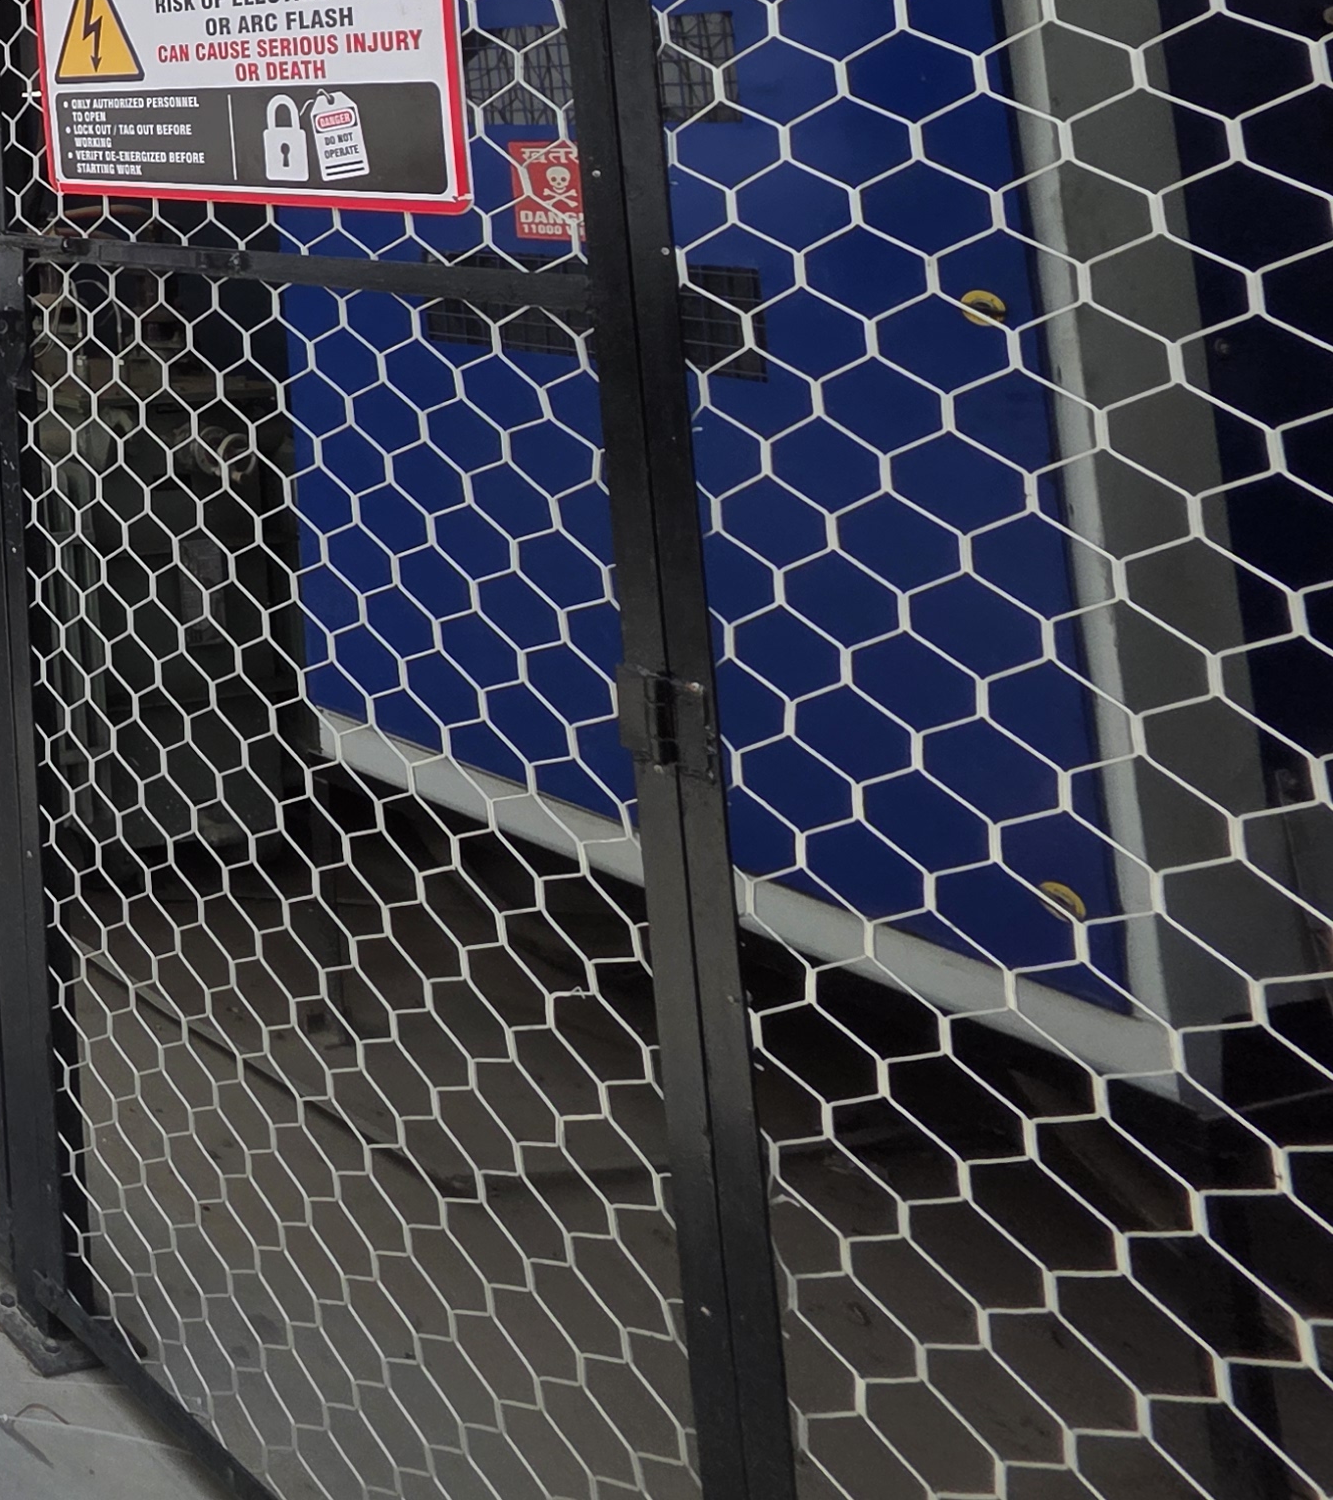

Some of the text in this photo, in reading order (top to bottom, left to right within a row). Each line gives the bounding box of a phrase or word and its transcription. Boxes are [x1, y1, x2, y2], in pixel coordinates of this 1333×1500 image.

[205, 7, 354, 36] OR ARC FLASH
[158, 29, 422, 63] CAN CAUSE SERIOUS INJURY
[235, 60, 326, 81] OR DEATH
[71, 96, 199, 110] ONLY AUTHORIZED PERSONNEL
[72, 111, 106, 122] TO OPEN
[319, 113, 350, 128] DANGER
[73, 124, 93, 135] LOCK
[95, 124, 112, 135] OUT
[118, 124, 135, 135] TAG
[136, 124, 154, 135] OUT
[156, 124, 192, 135] BEFORE
[74, 137, 112, 148] WORKING
[324, 132, 353, 146] DO NOT
[75, 151, 205, 163] VERIFY DE-ENERGIZED BEFORE
[324, 144, 359, 159] OPERATE
[77, 163, 142, 175] STARTING WORK
[520, 210, 584, 224] DANG
[523, 224, 562, 235] 11000
